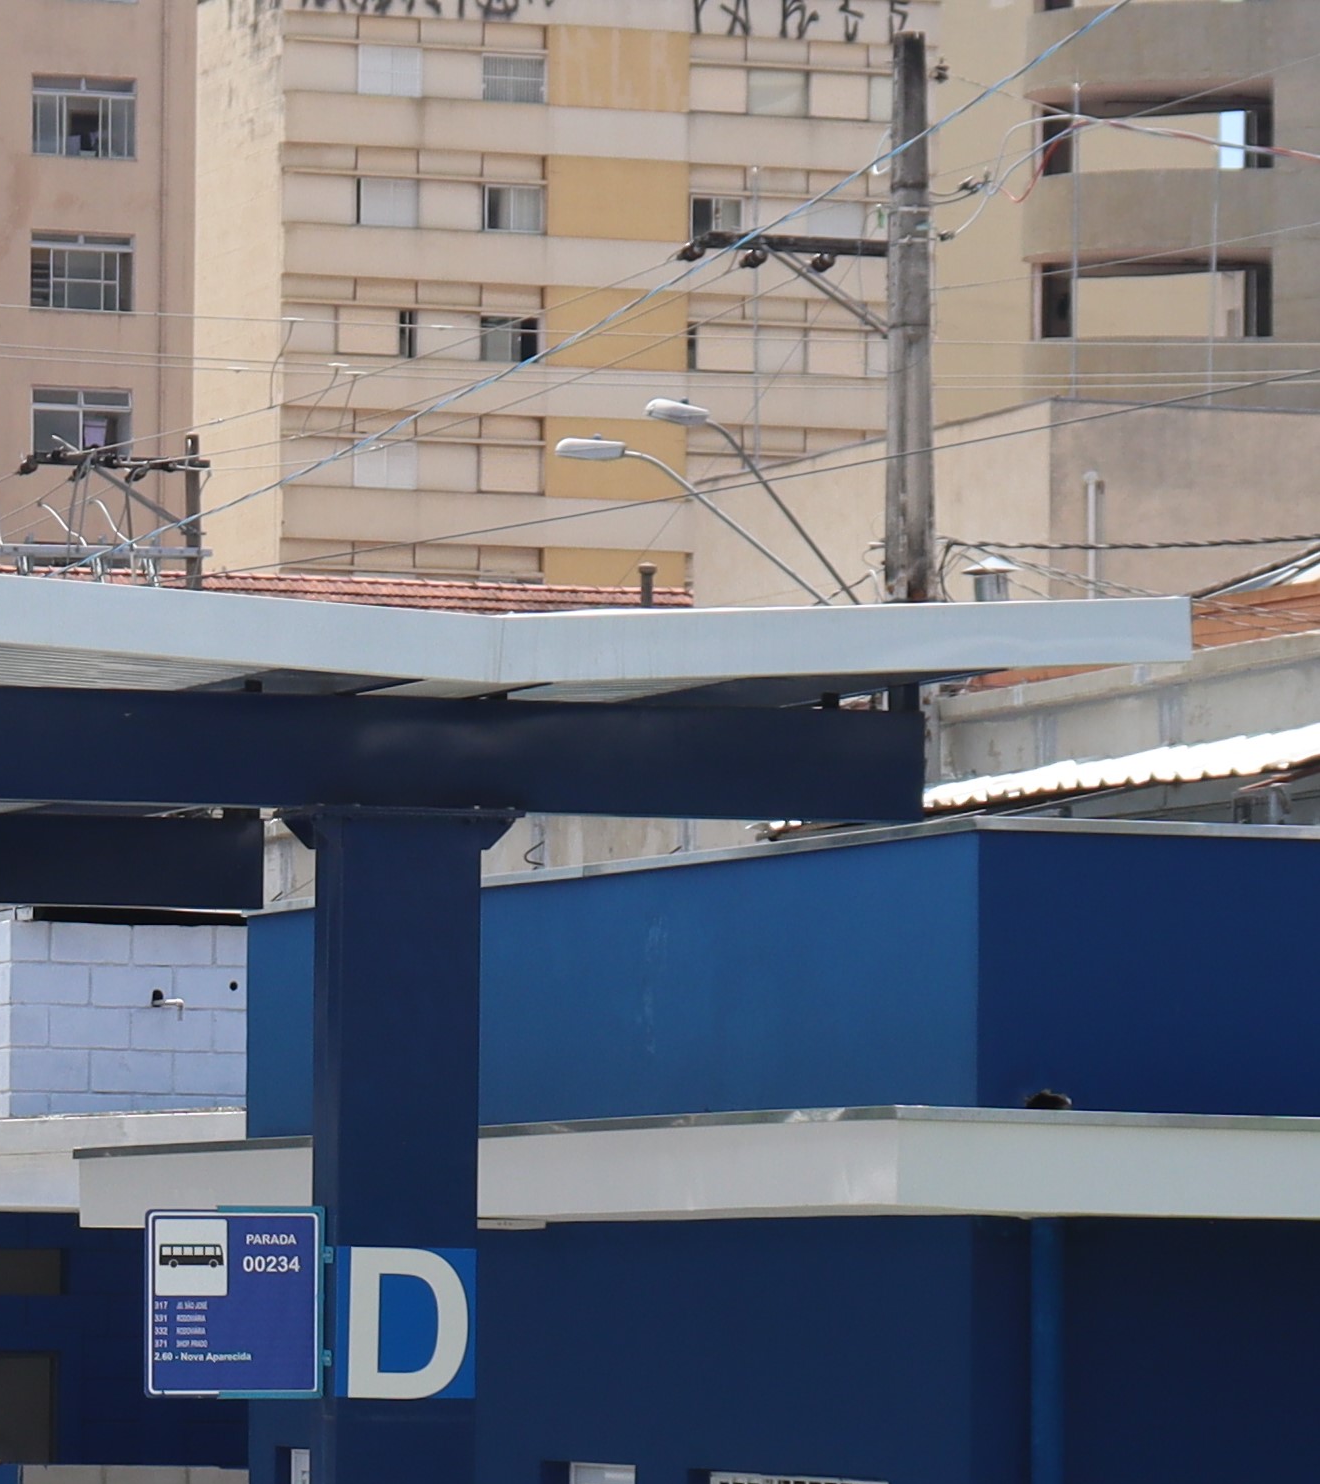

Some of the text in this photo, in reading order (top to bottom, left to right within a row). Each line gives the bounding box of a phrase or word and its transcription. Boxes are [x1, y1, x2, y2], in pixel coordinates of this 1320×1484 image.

[246, 1233, 297, 1245] PARADA
[242, 1255, 301, 1273] 00234
[348, 1246, 469, 1399] D
[154, 1352, 173, 1361] 2.60
[180, 1352, 204, 1361] Nova
[205, 1351, 252, 1363] Aparecida
